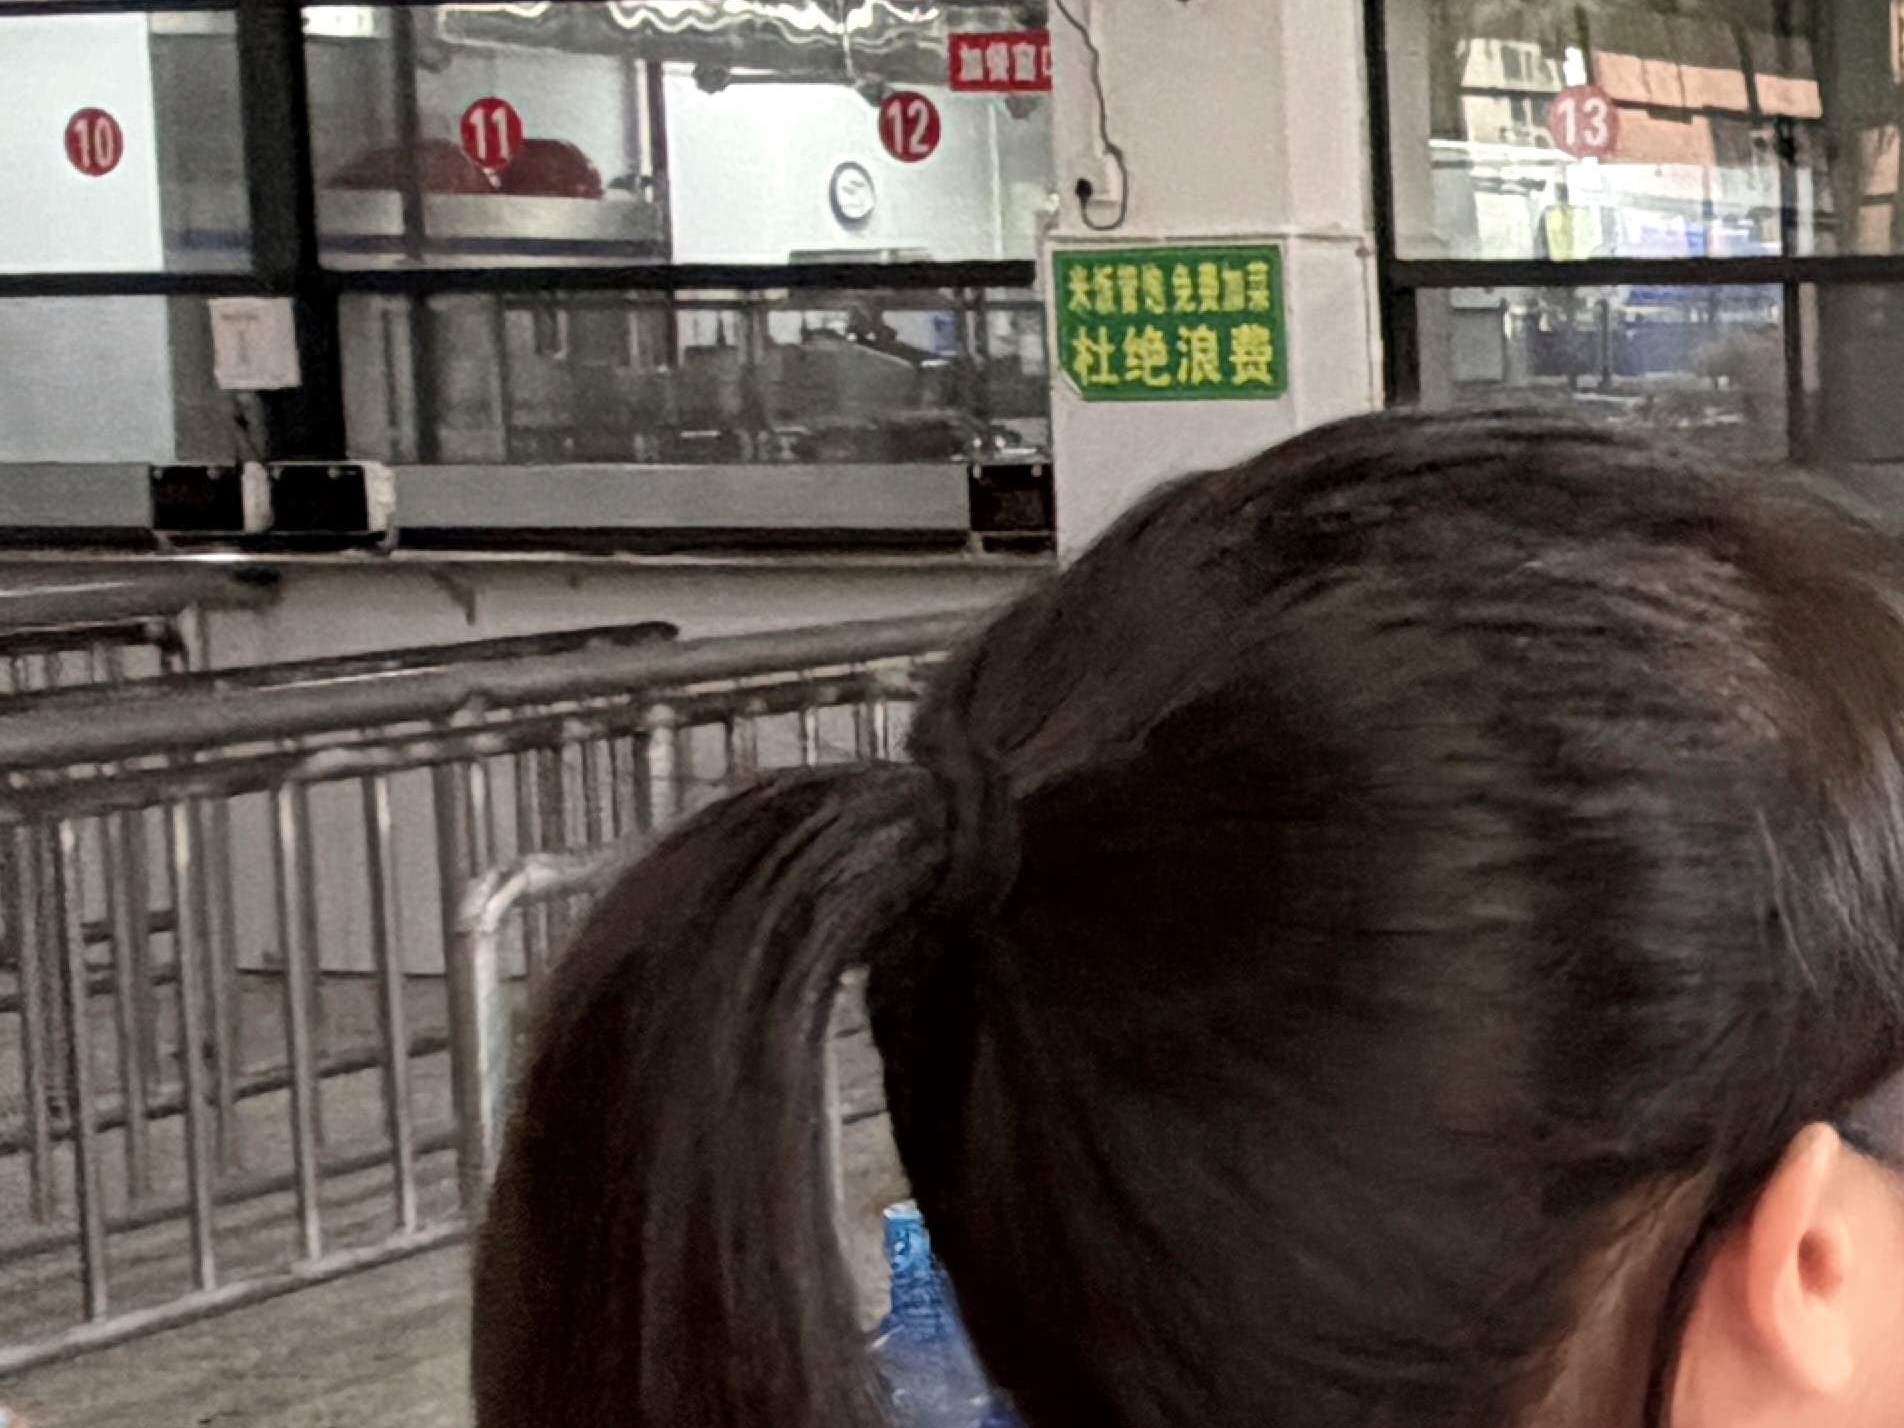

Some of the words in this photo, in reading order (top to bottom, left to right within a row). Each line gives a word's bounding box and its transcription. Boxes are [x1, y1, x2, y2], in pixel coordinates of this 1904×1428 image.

[73, 123, 114, 170] 10
[468, 107, 511, 158] 11
[887, 101, 932, 152] 12
[1557, 95, 1611, 148] 13
[1072, 323, 1274, 388] 杜绝浪费
